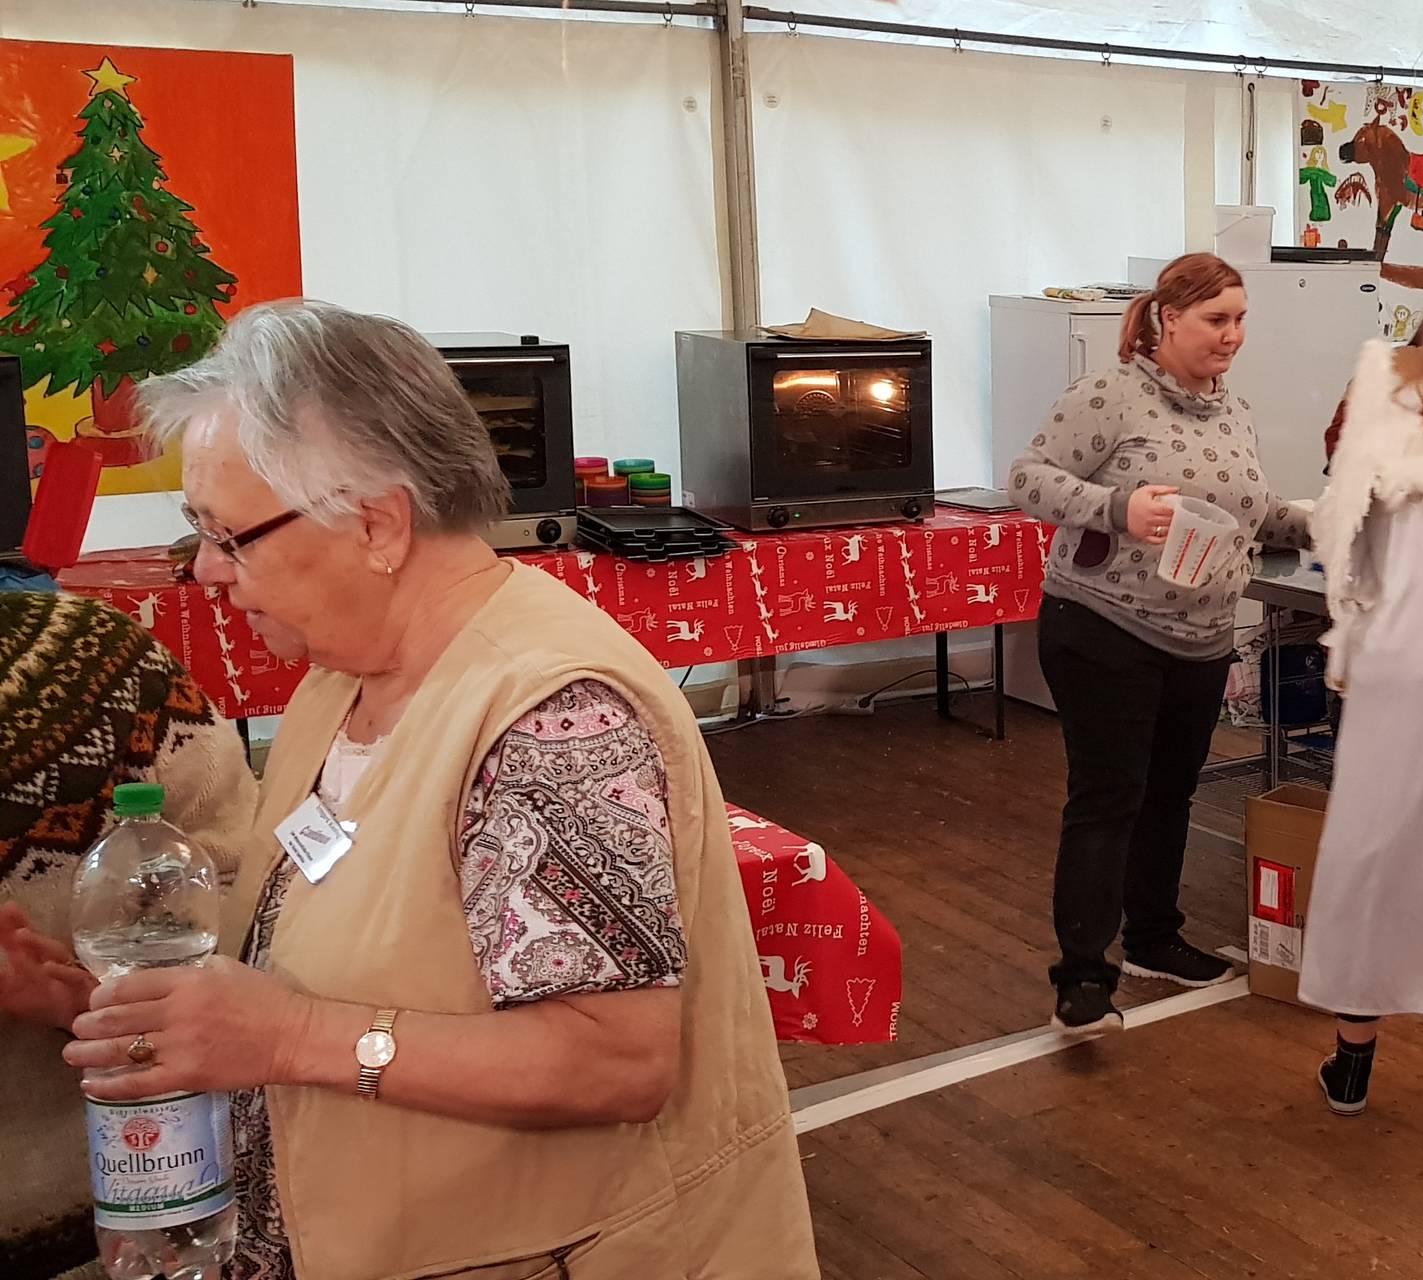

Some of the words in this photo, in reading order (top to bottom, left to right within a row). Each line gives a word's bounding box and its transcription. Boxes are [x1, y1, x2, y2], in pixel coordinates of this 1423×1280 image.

[723, 560, 735, 615] Weihnachten
[668, 602, 694, 613] Natal
[761, 868, 778, 917] Noël
[756, 922, 799, 941] Natal
[803, 924, 844, 940] Feliz
[95, 1146, 205, 1176] Quellbrunn
